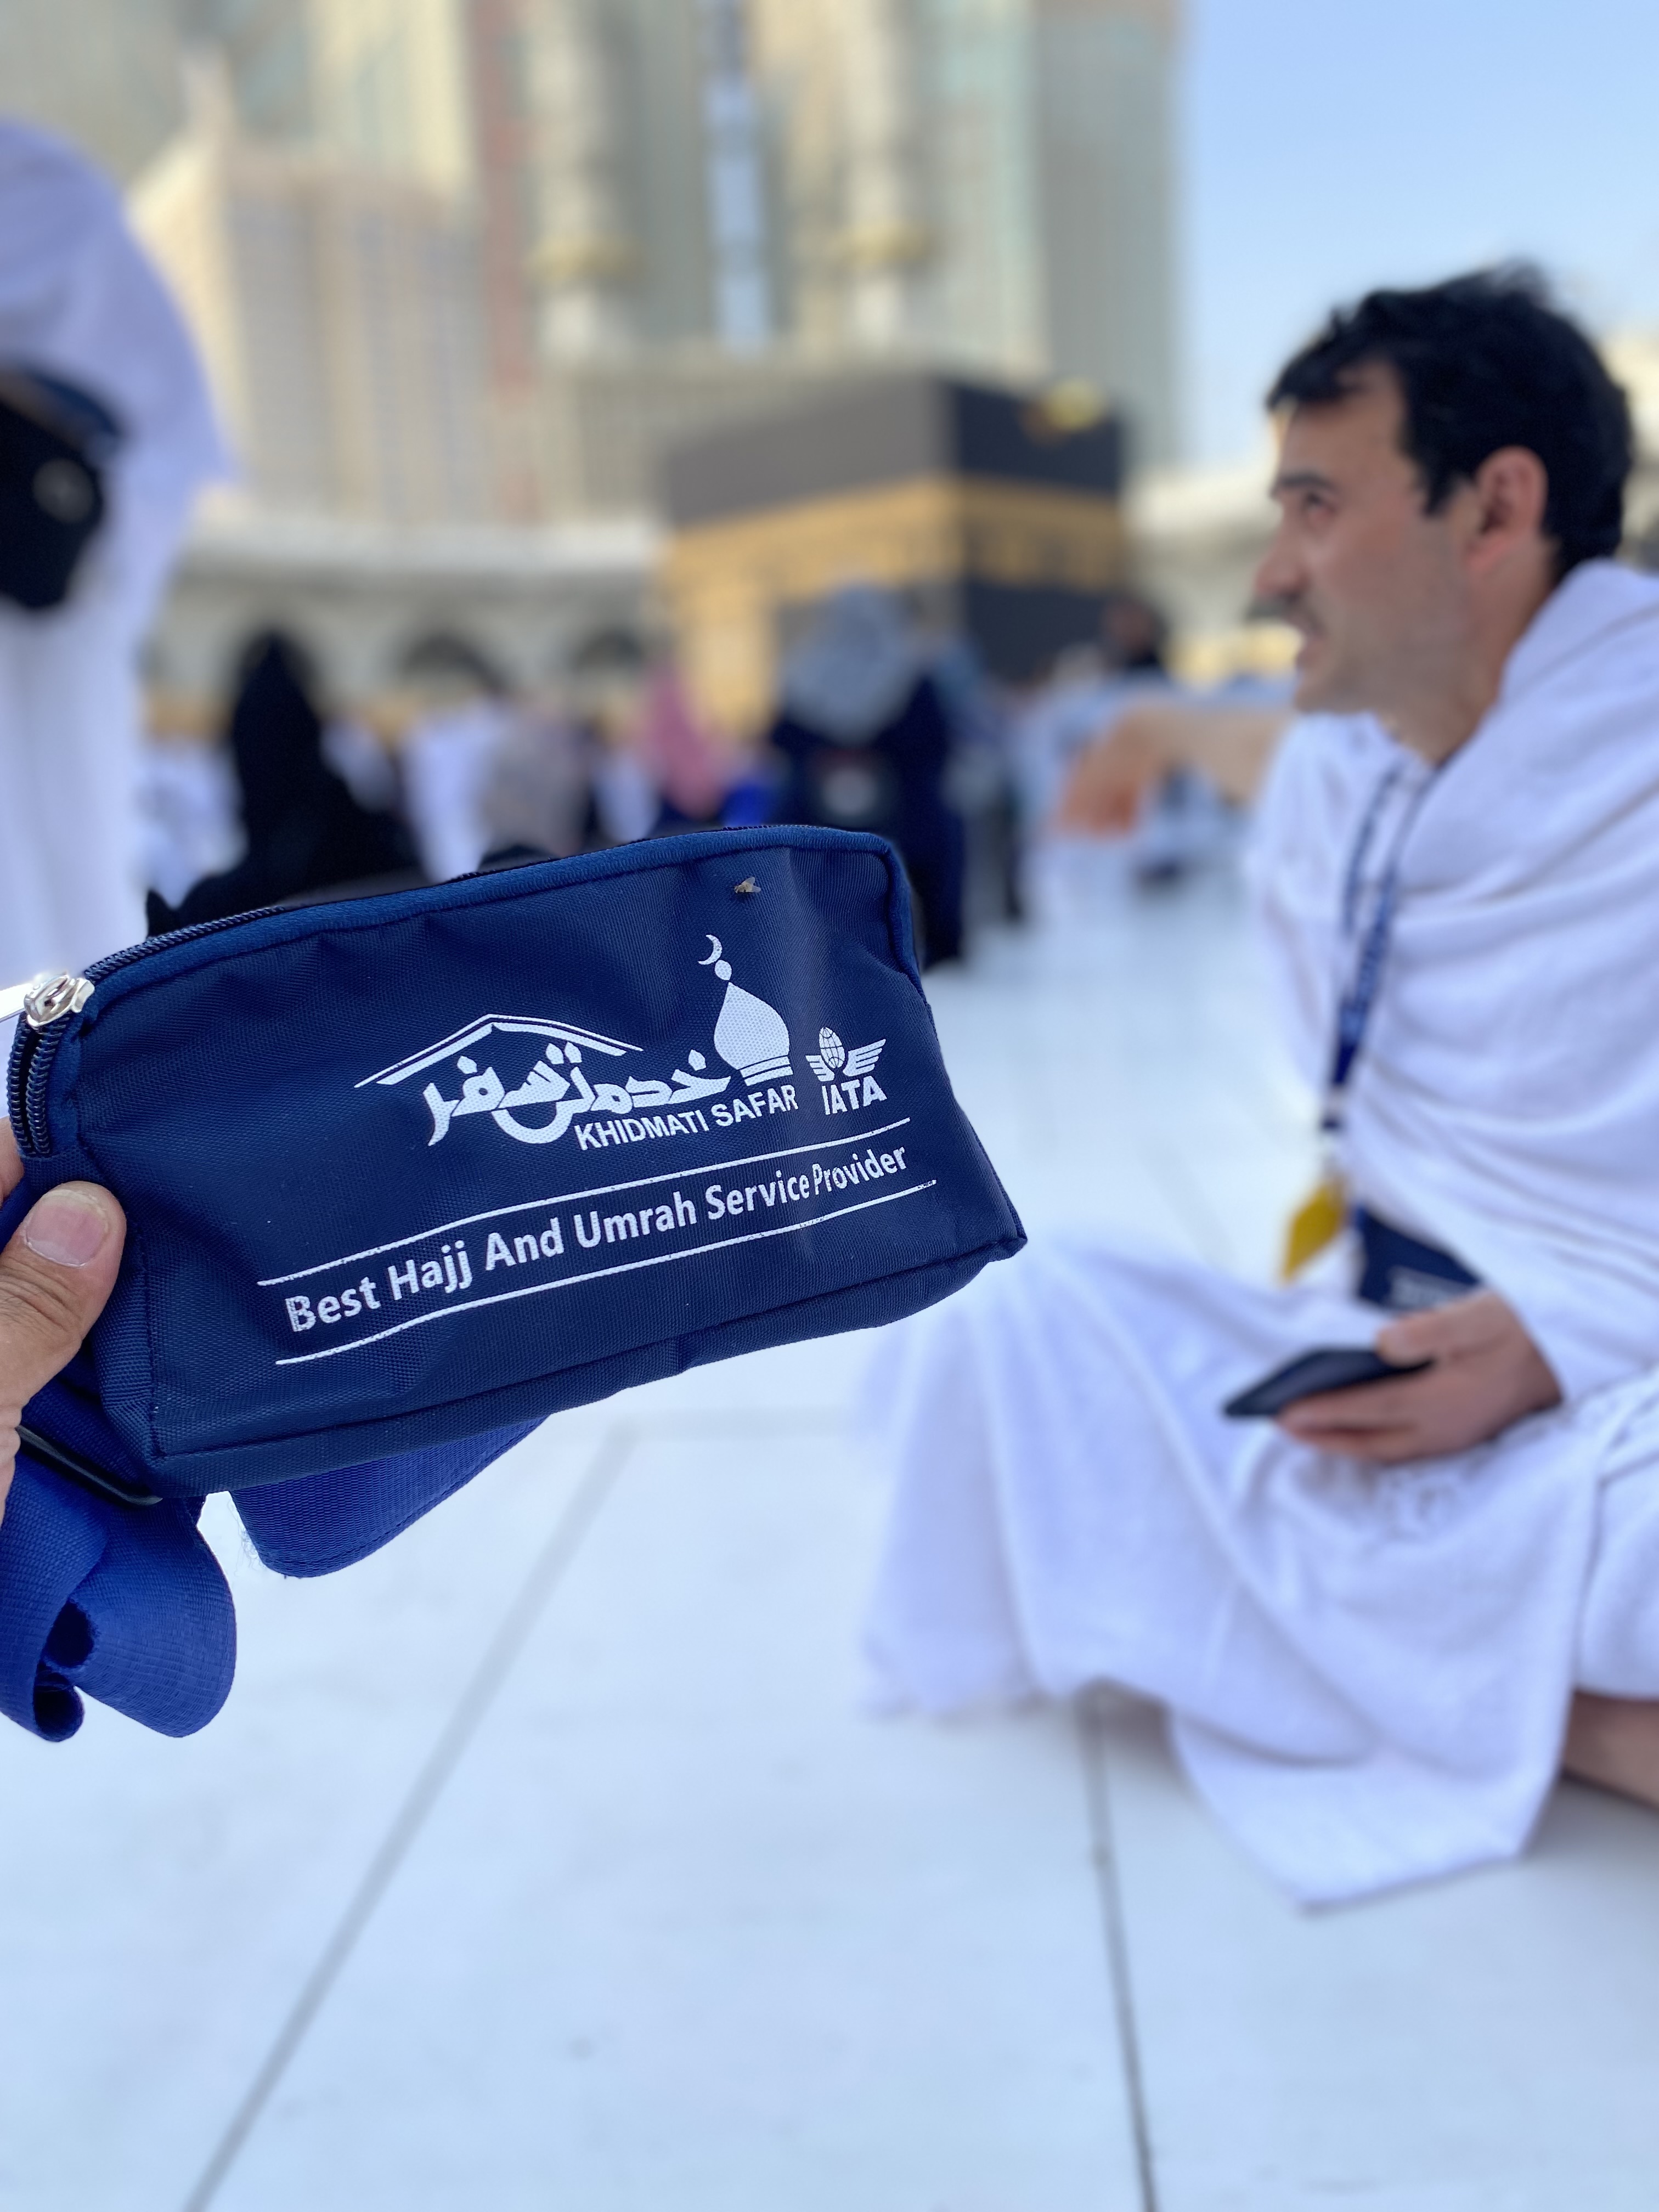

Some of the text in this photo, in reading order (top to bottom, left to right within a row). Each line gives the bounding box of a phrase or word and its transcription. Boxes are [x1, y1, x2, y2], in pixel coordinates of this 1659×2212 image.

[573, 1084, 799, 1151] KHIDMATI SAFAR
[822, 1075, 888, 1116] IATA
[285, 1146, 907, 1332] Best Hajj And Umrah Service Provider
